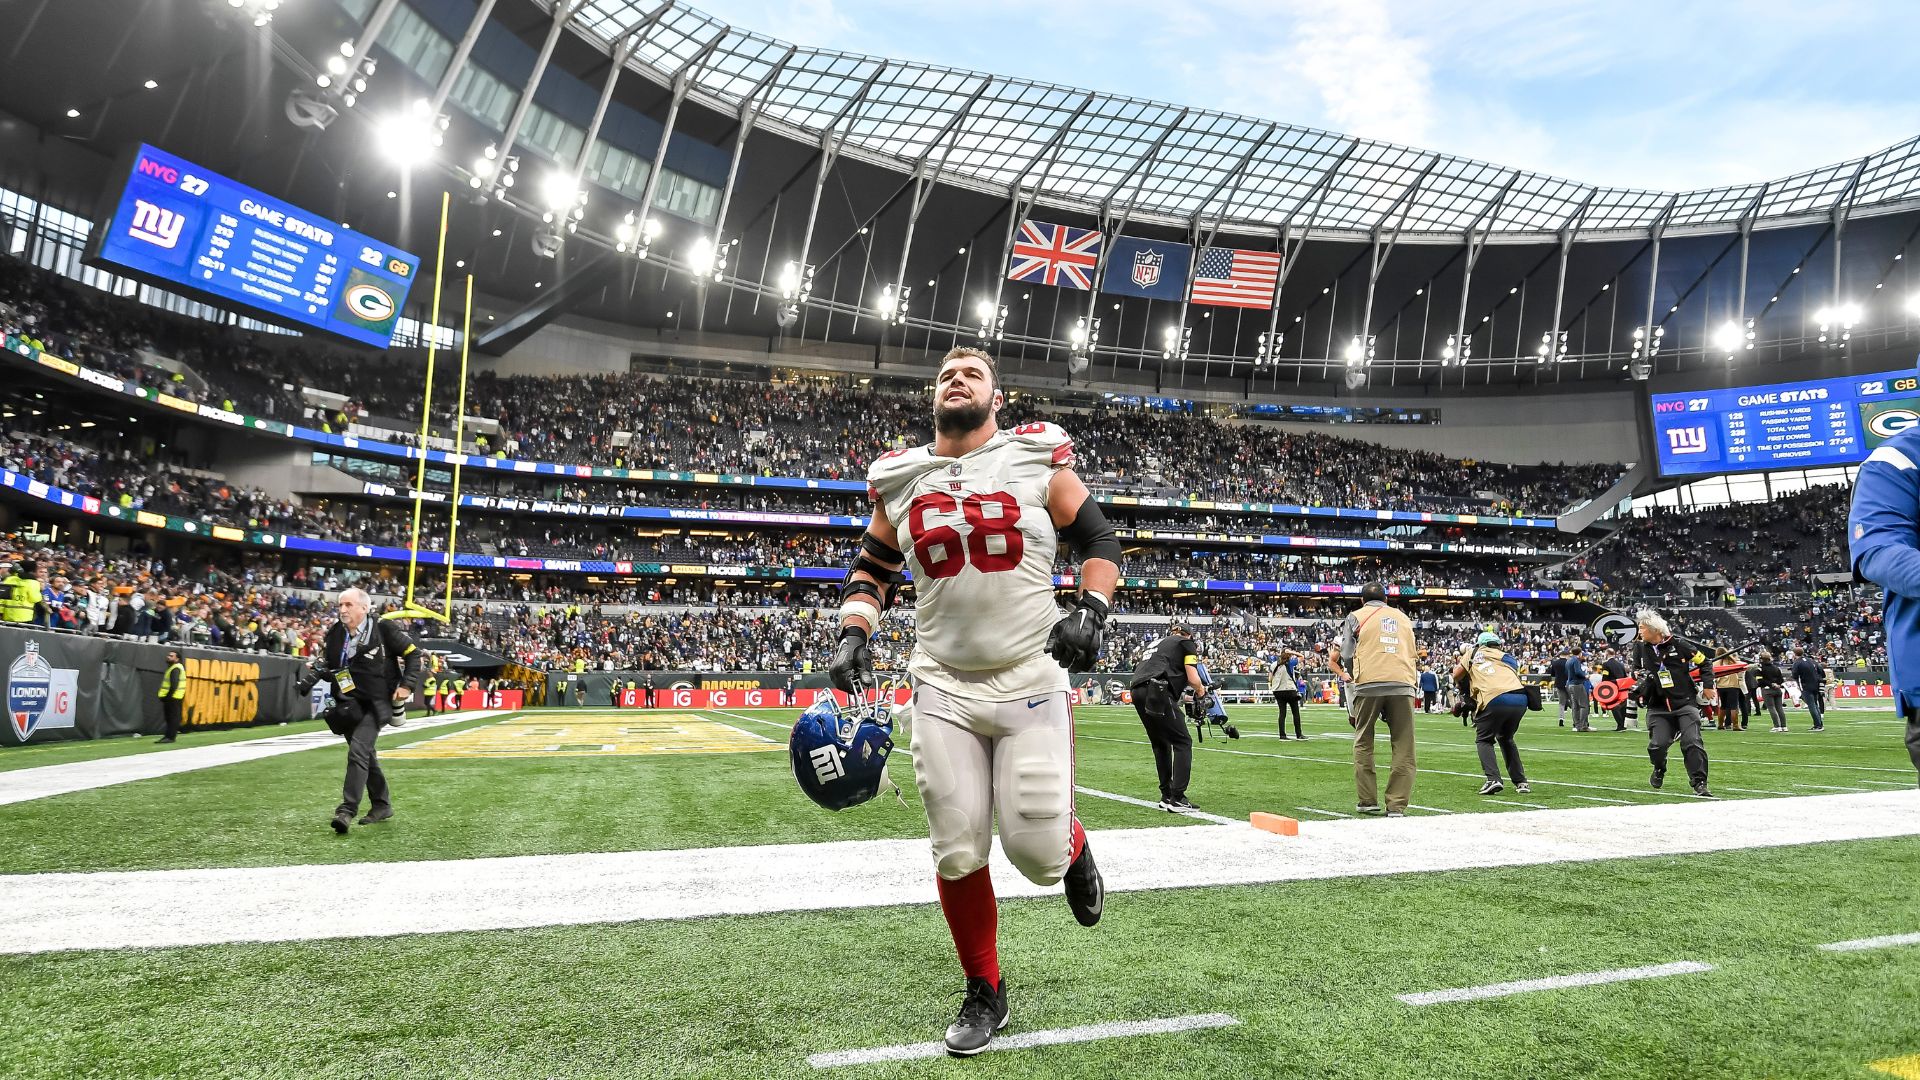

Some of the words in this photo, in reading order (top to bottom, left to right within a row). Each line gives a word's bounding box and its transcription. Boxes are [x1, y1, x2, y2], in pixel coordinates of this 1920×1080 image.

[139, 158, 178, 184] NYG
[180, 174, 209, 196] 27
[240, 199, 285, 227] GAME
[284, 217, 333, 246] STATS
[360, 247, 382, 266] 22
[389, 260, 410, 276] GB
[1135, 265, 1157, 282] NFL
[1861, 381, 1884, 395] 22
[1894, 379, 1917, 390] GB
[1738, 393, 1778, 406] GAME
[1780, 388, 1828, 402] STATS
[1656, 401, 1685, 412] NYG
[1689, 398, 1709, 412] 27
[1790, 415, 1812, 423] YARDS
[1787, 424, 1809, 432] YARDS
[1666, 427, 1708, 454] ny
[909, 491, 1024, 579] 68
[545, 560, 581, 571] GIANTS
[11, 686, 48, 698] LONDON
[624, 690, 636, 705] IG
[673, 691, 692, 706] IG
[709, 691, 728, 706] IG
[744, 691, 763, 706] IG
[1842, 686, 1851, 697] IG
[1858, 686, 1867, 697] IG
[1873, 686, 1883, 697] IG
[55, 691, 68, 714] IG
